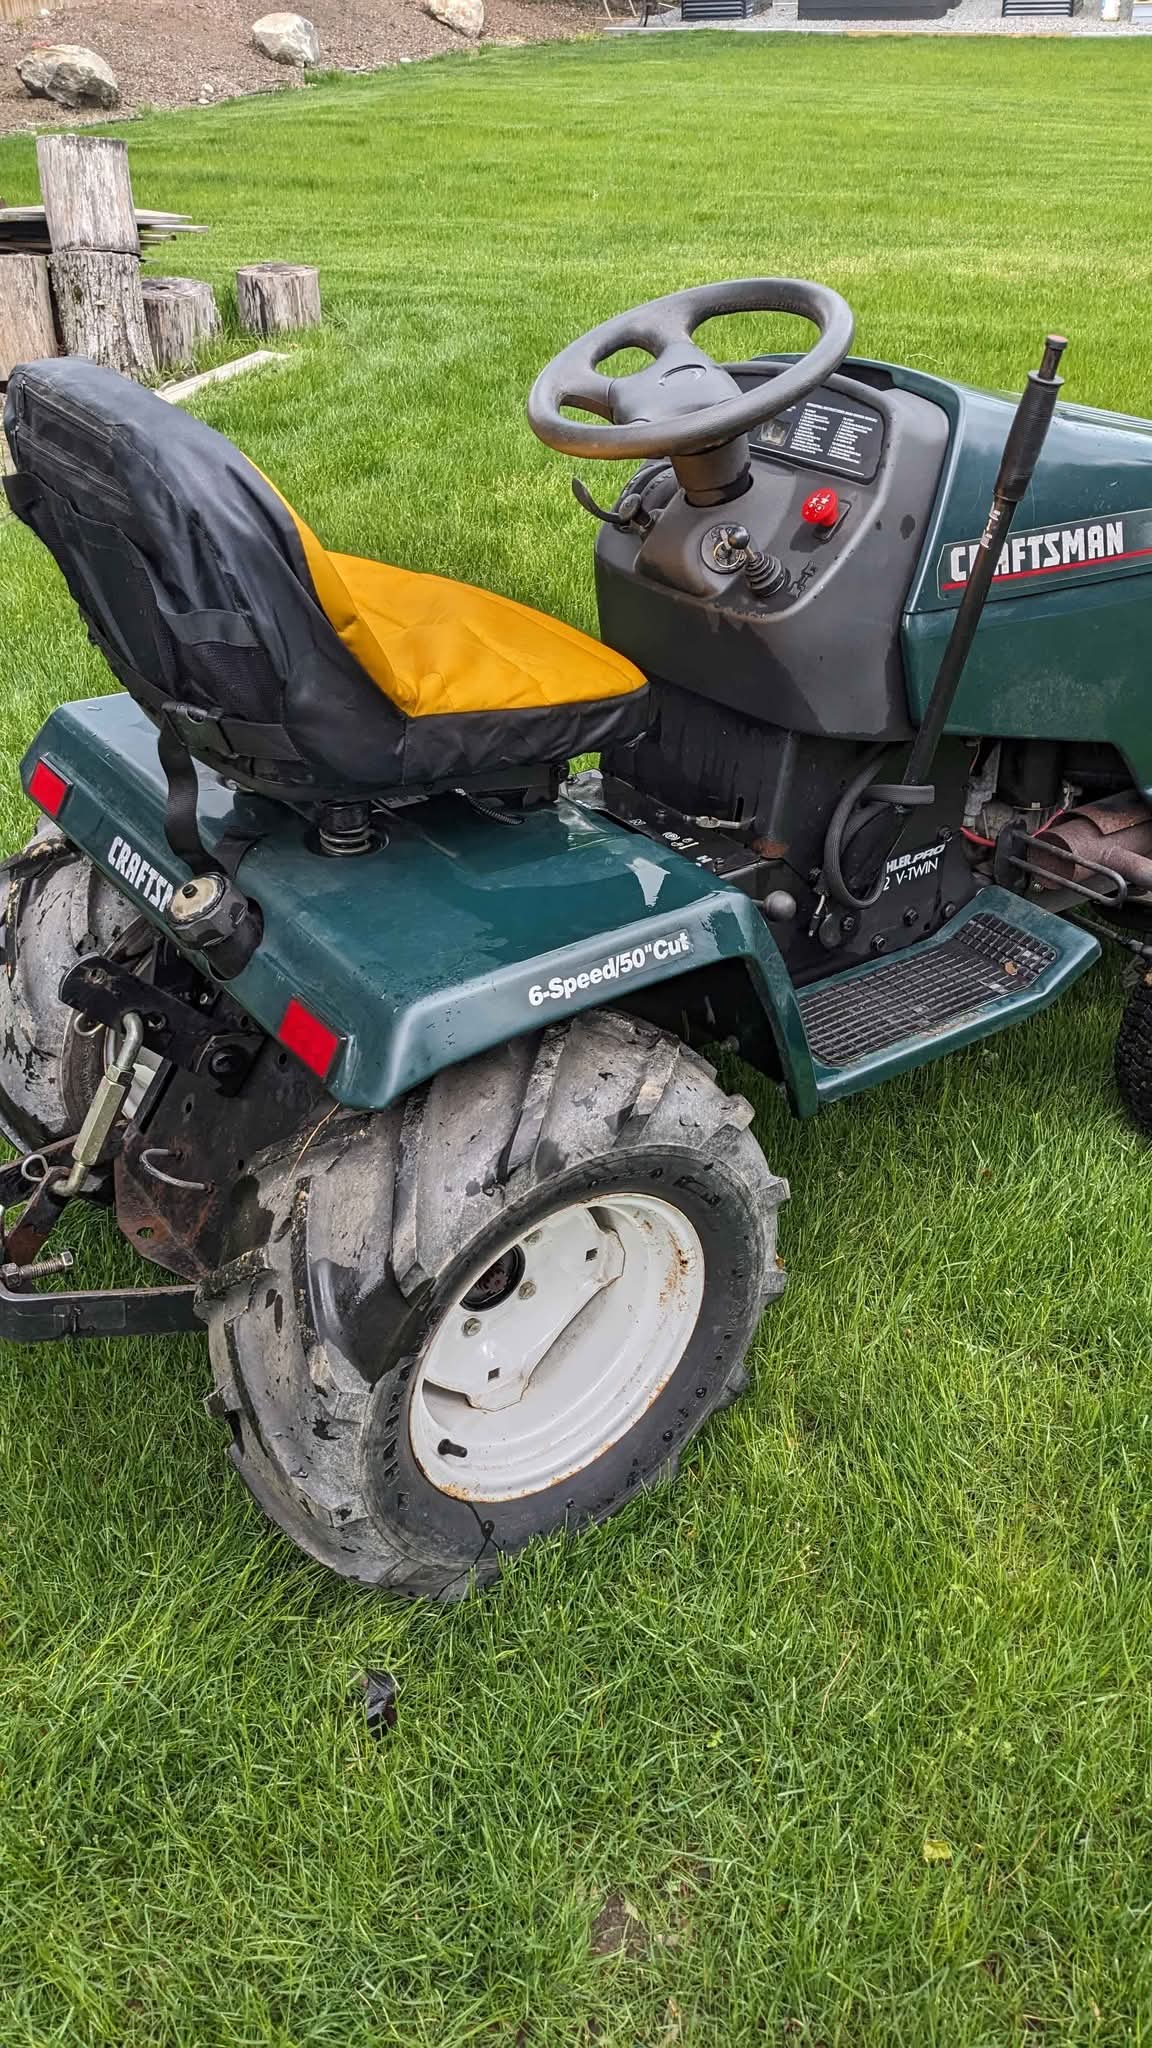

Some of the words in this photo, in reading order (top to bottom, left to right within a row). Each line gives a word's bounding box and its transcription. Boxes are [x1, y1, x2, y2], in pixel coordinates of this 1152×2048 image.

[950, 520, 1124, 582] CAFTSMAN
[107, 835, 176, 913] CRAFTS
[886, 854, 912, 874] HLER
[911, 843, 946, 863] PRO
[896, 857, 938, 885] V-TWIN
